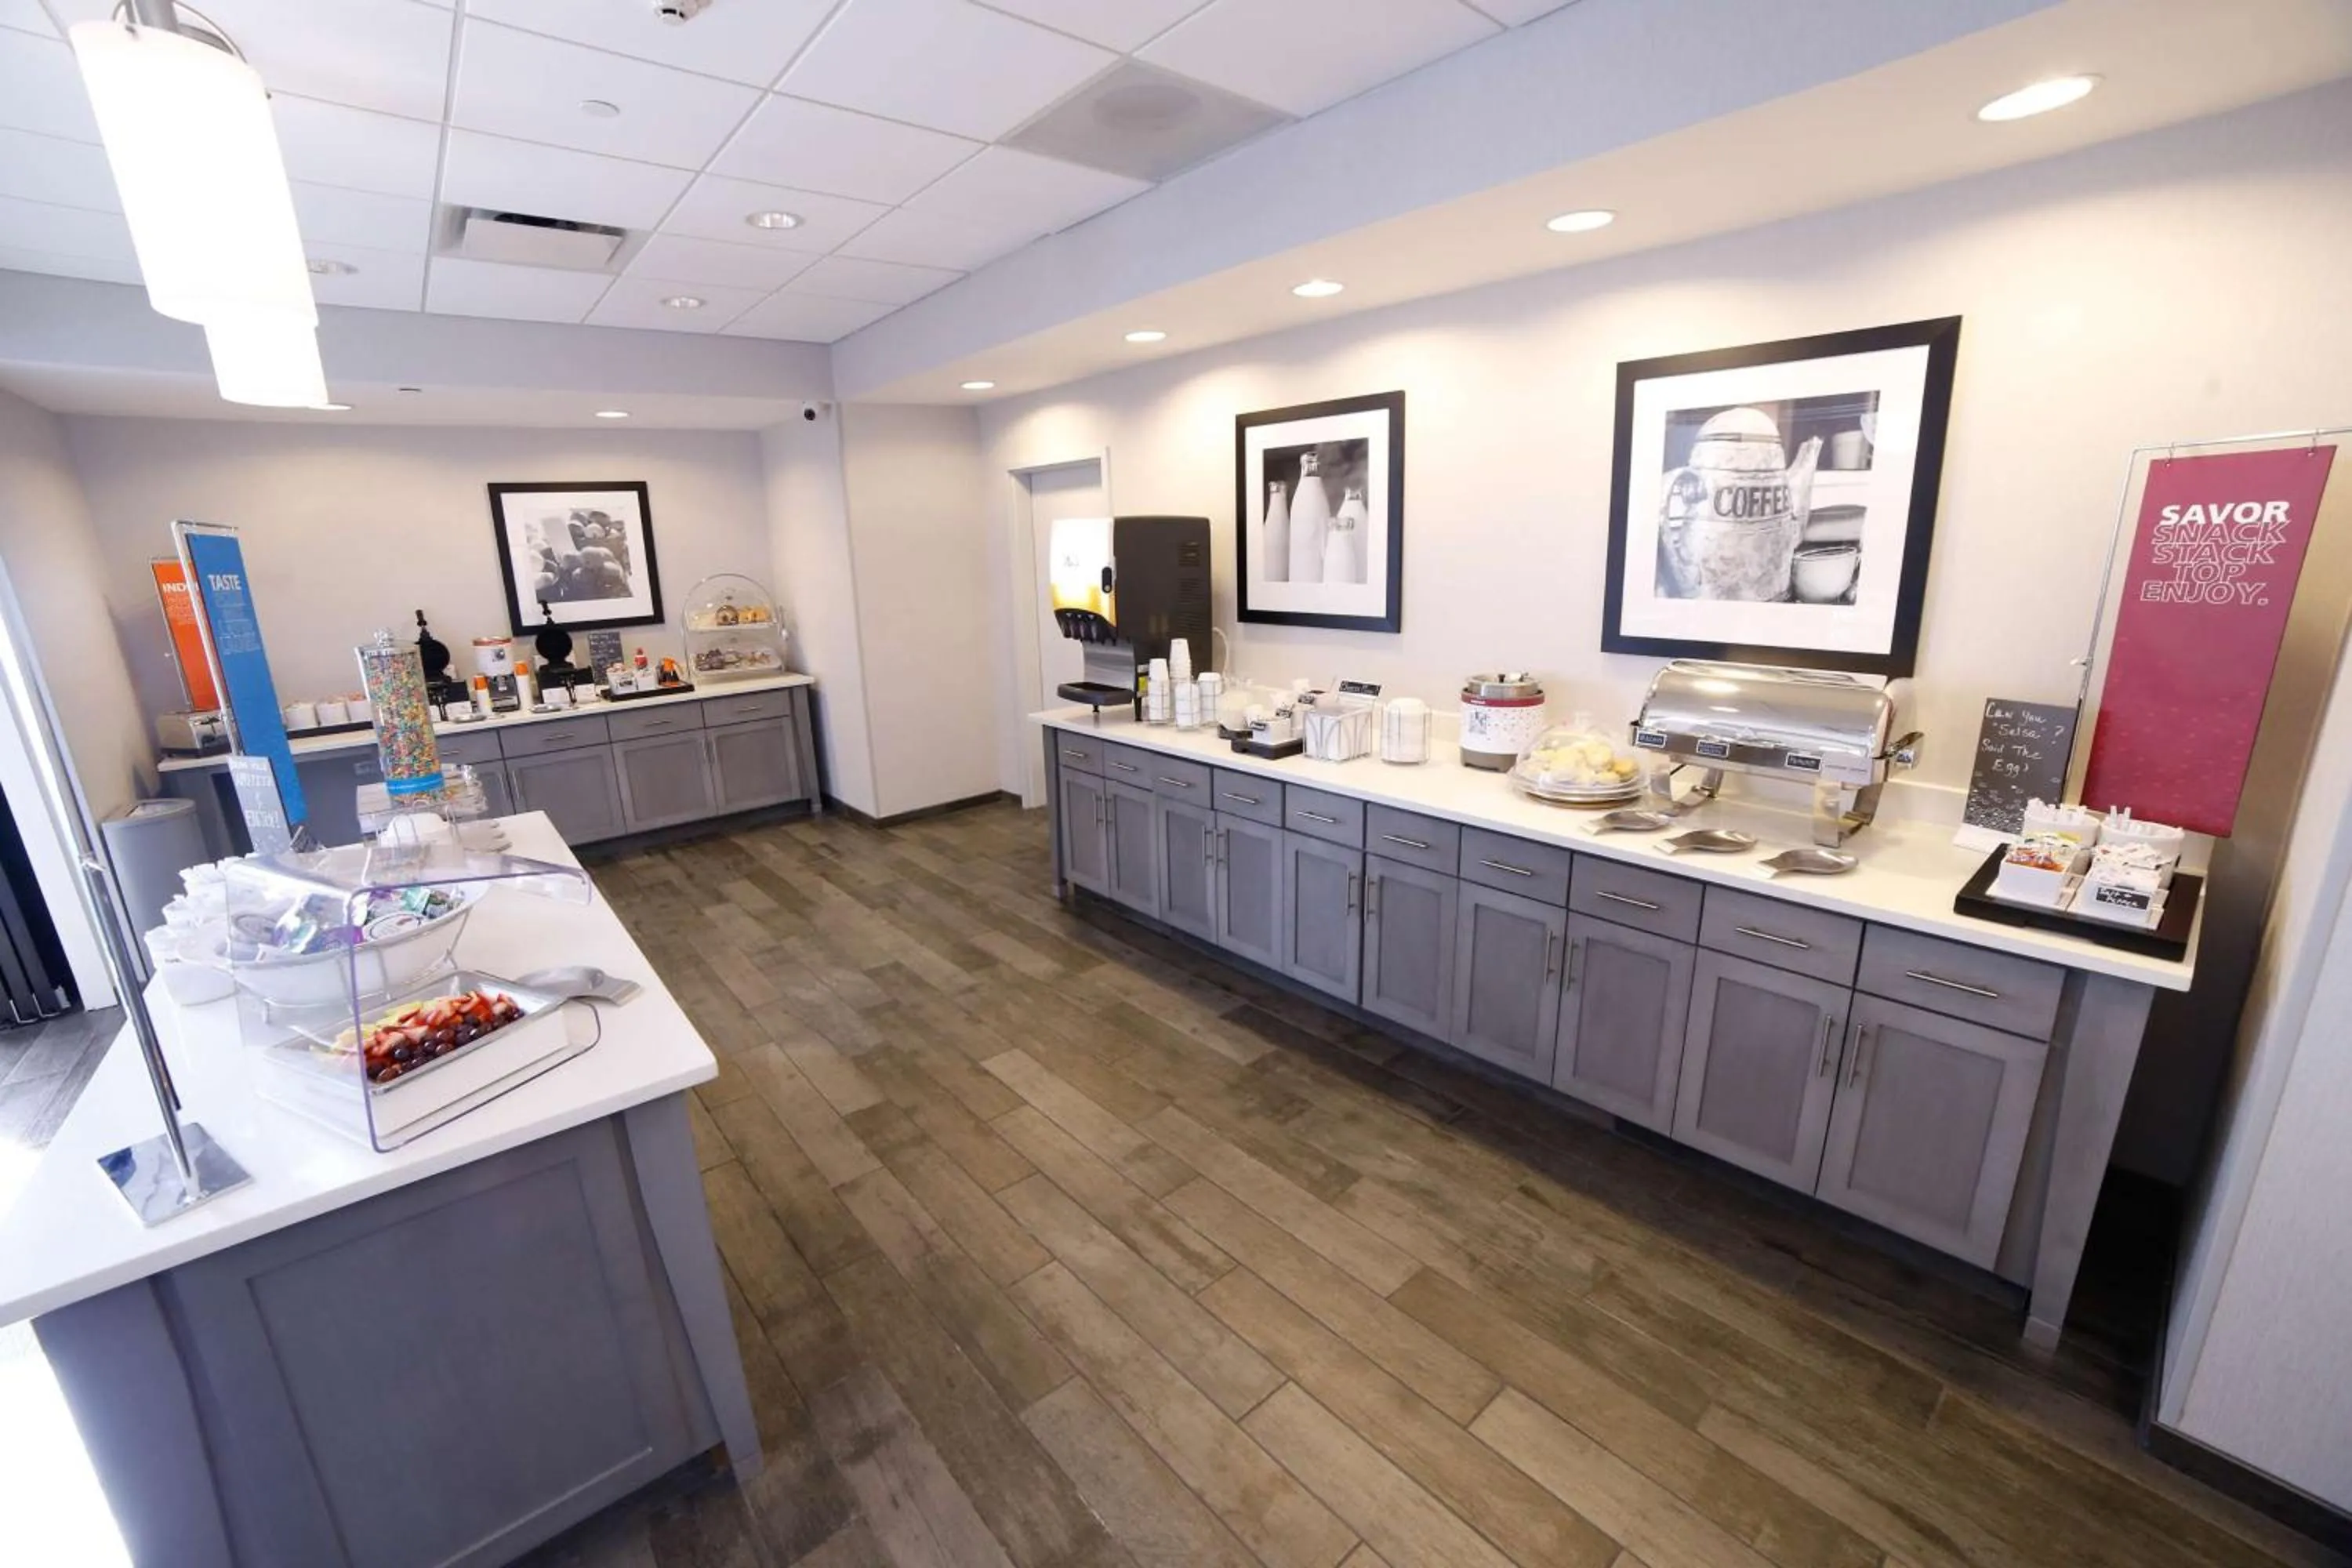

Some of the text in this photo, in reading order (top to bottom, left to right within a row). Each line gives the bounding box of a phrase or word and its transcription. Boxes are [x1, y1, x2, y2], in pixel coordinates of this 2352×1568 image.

[1713, 485, 1790, 517] COFFEE
[2159, 500, 2290, 525] SAVOR
[2151, 521, 2292, 545] SNACK
[2152, 542, 2281, 564] STACK
[207, 574, 242, 591] TASTE
[2173, 561, 2246, 583] TOP
[2140, 580, 2269, 606] ENJOY.
